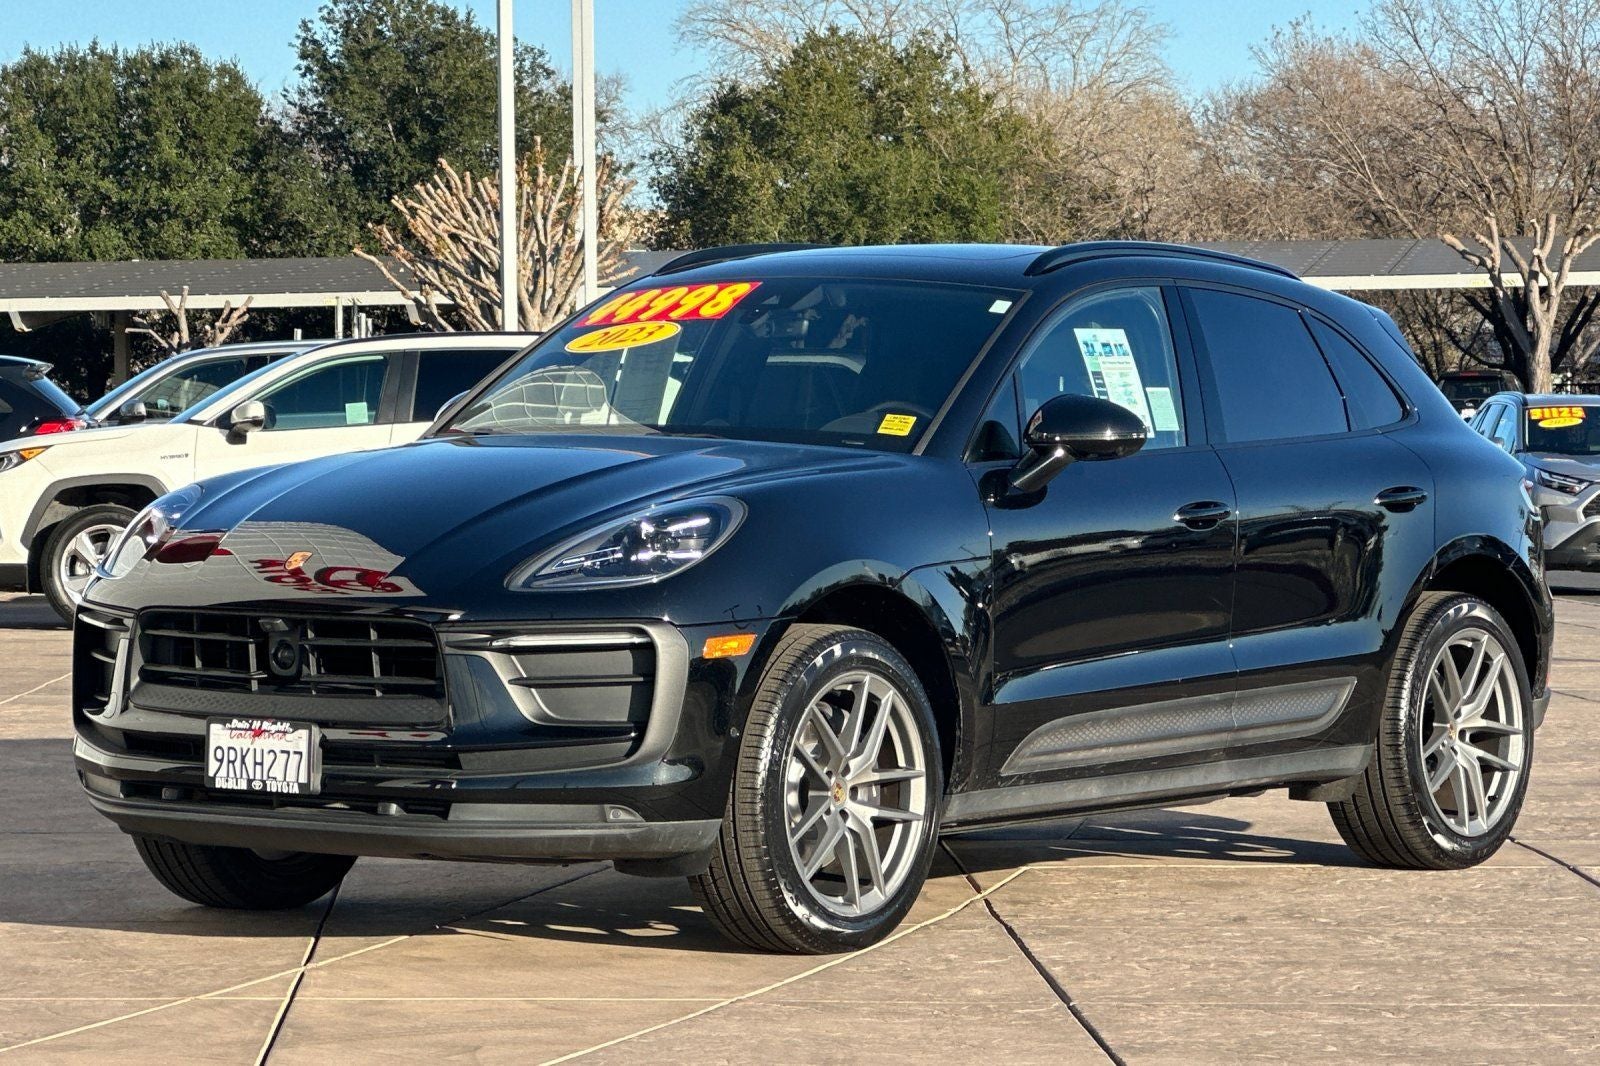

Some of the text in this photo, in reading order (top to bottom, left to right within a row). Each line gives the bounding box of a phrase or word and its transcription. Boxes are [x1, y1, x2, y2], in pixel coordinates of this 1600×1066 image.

[585, 283, 751, 325] 44998
[577, 325, 666, 349] 2023
[214, 745, 303, 782] 9RKH277
[215, 777, 299, 794] DUBLIN TOYOTA
